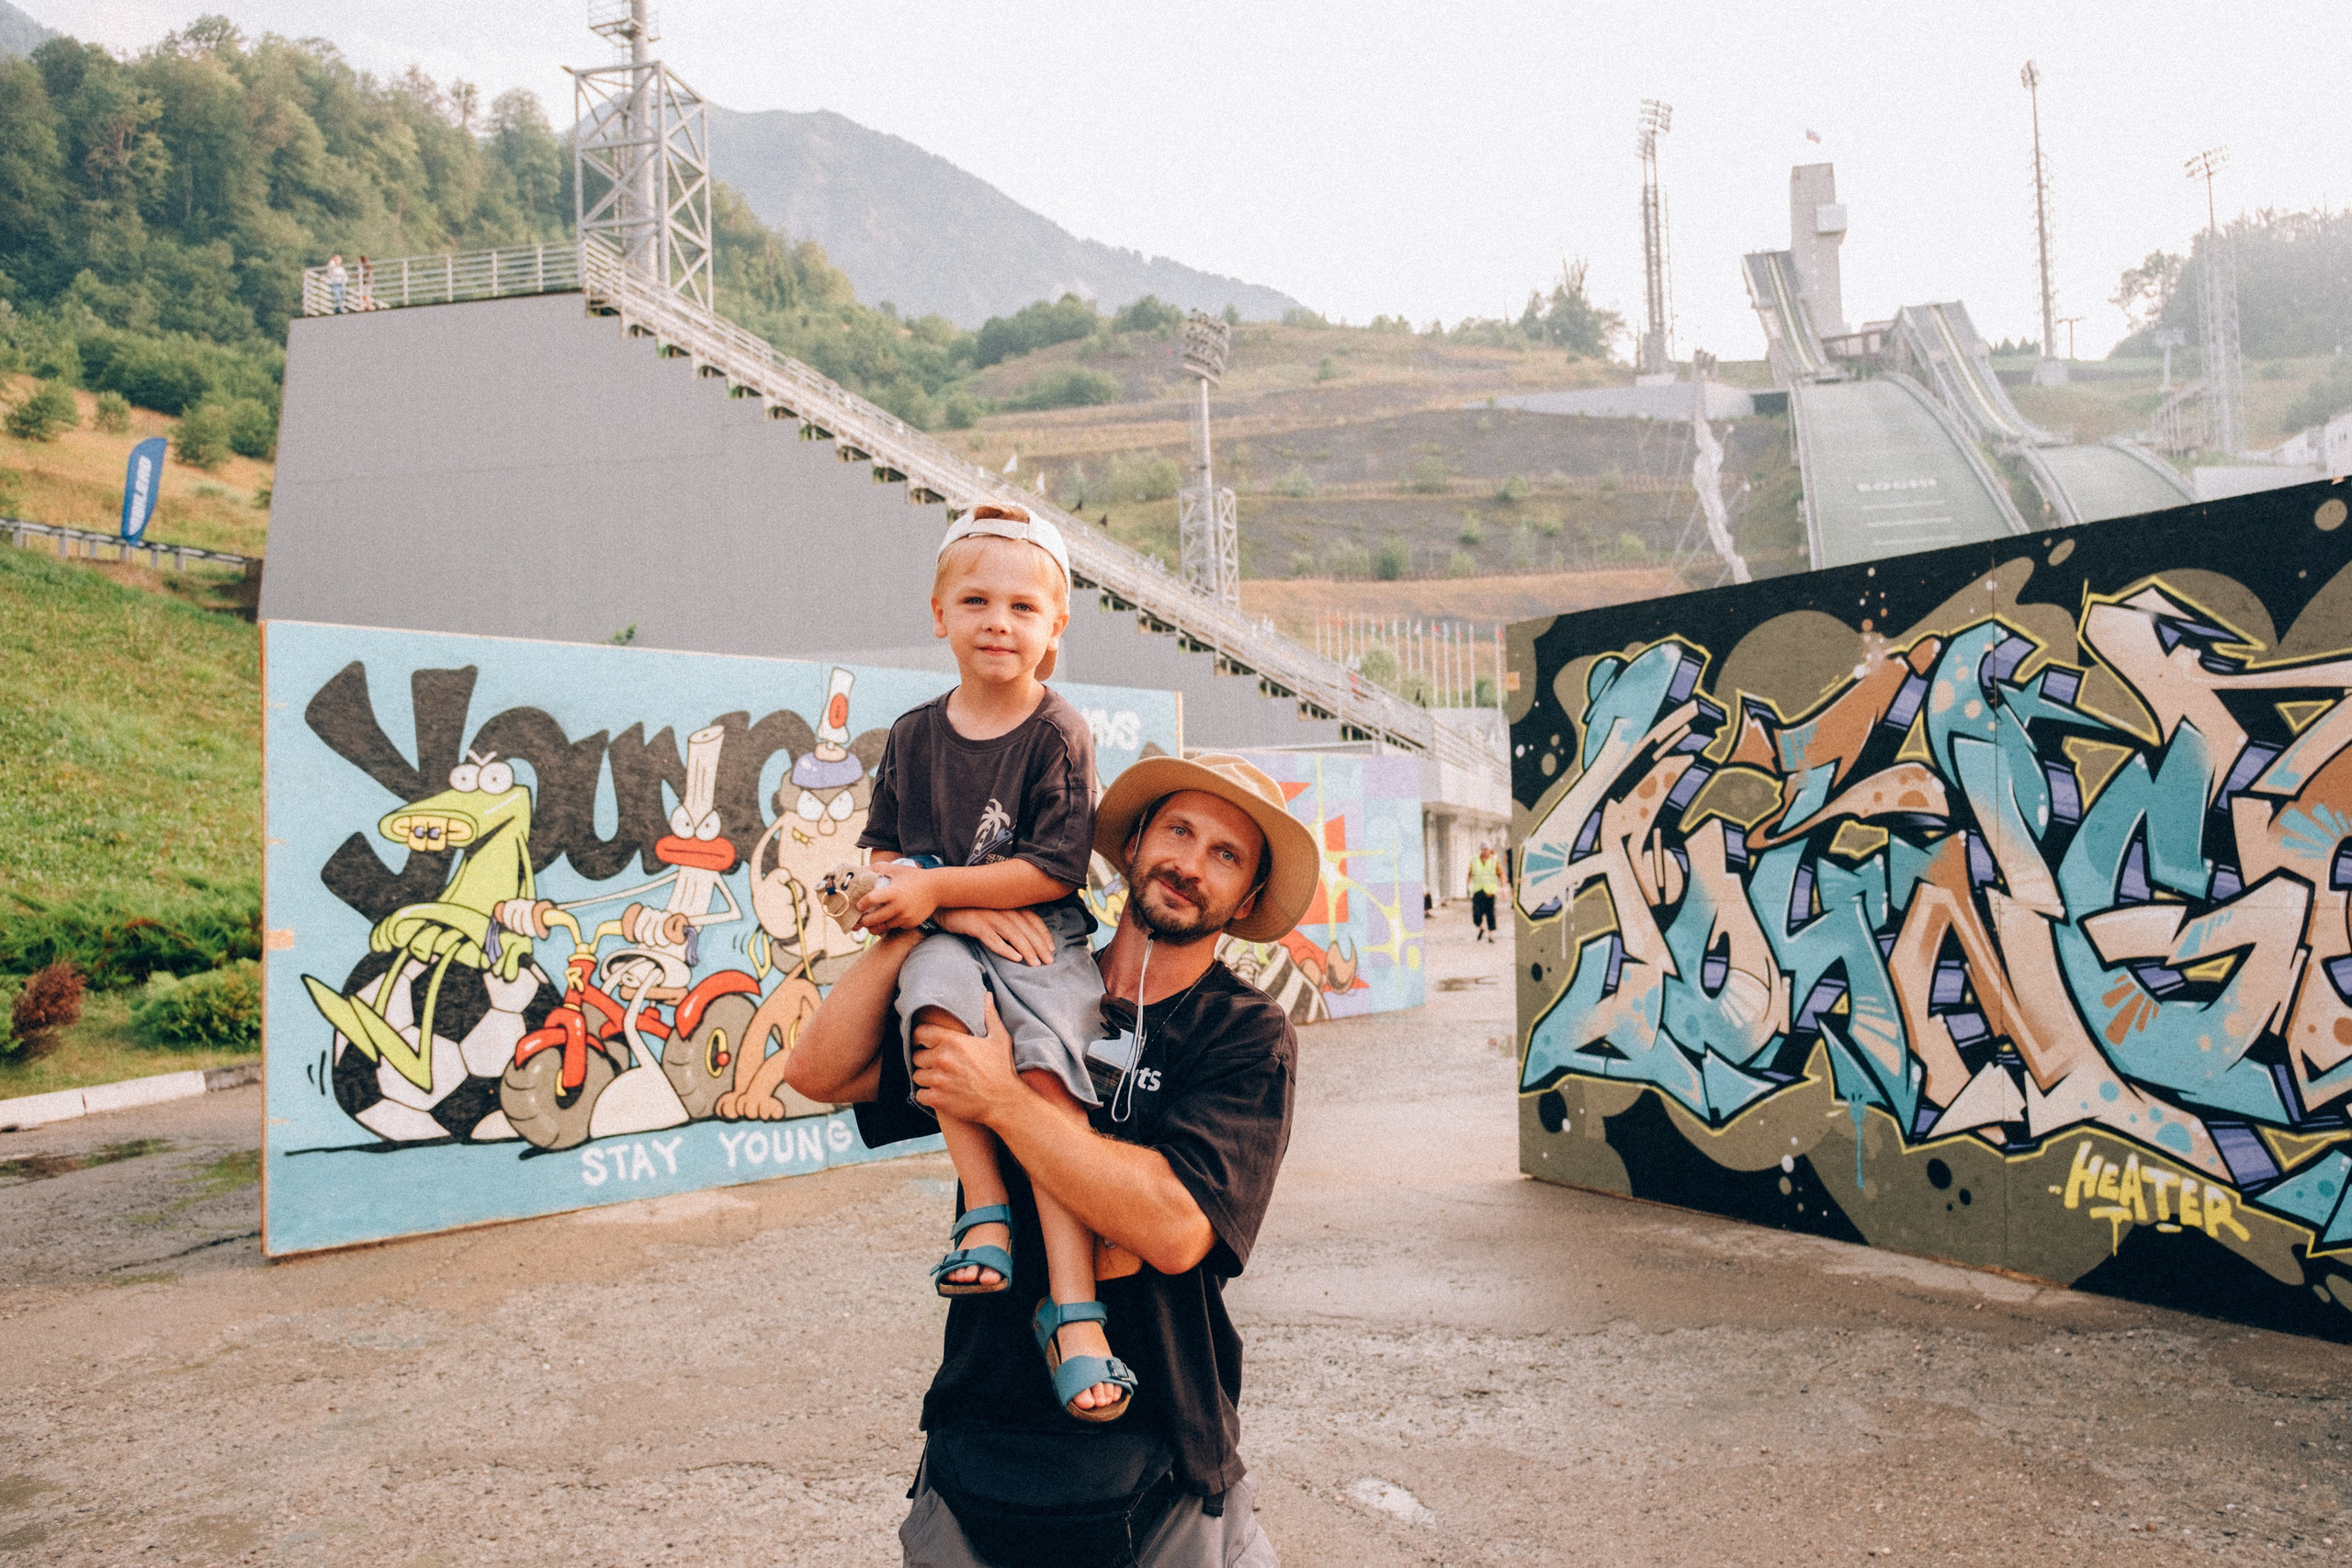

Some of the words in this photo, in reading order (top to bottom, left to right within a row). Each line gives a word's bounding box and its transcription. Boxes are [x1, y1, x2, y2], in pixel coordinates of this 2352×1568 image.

[564, 966, 584, 993] R
[1134, 1067, 1162, 1091] ts
[581, 1135, 683, 1186] STAY
[718, 1120, 854, 1168] YOUNG
[2064, 1141, 2251, 1243] HEATER
